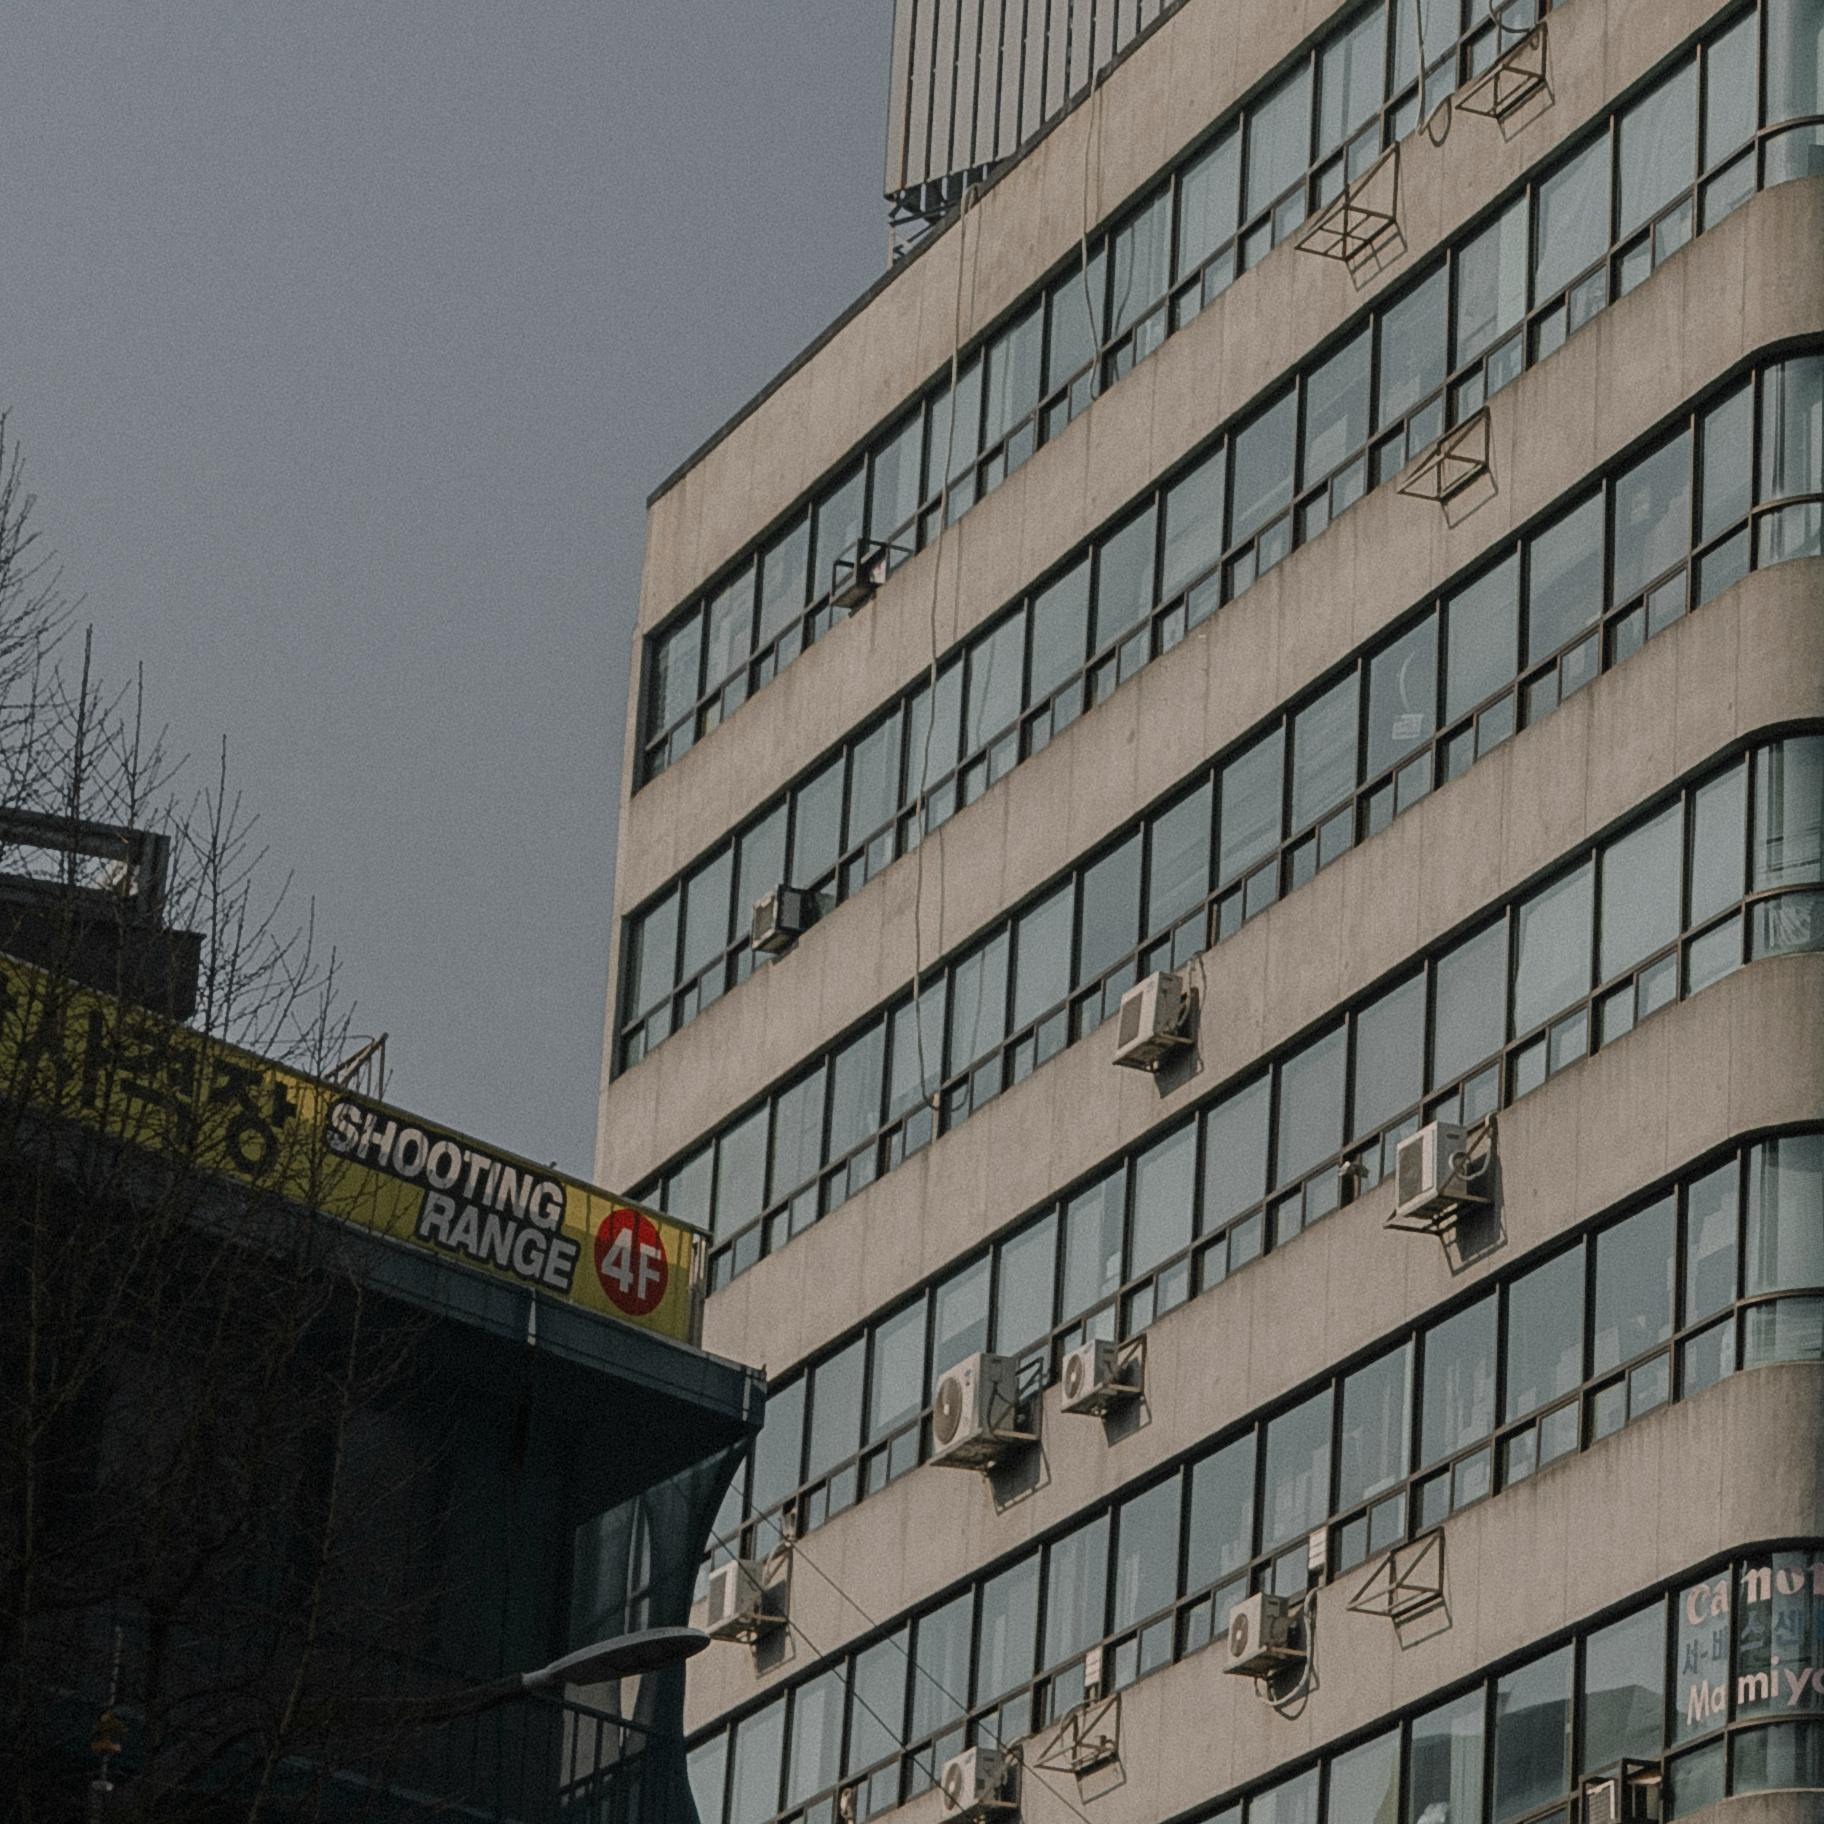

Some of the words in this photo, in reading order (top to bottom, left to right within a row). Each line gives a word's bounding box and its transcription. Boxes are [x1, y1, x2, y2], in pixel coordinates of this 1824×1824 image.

[328, 1100, 566, 1232] SHOOTING
[420, 1188, 579, 1293] RANGE
[601, 1228, 662, 1301] 4F
